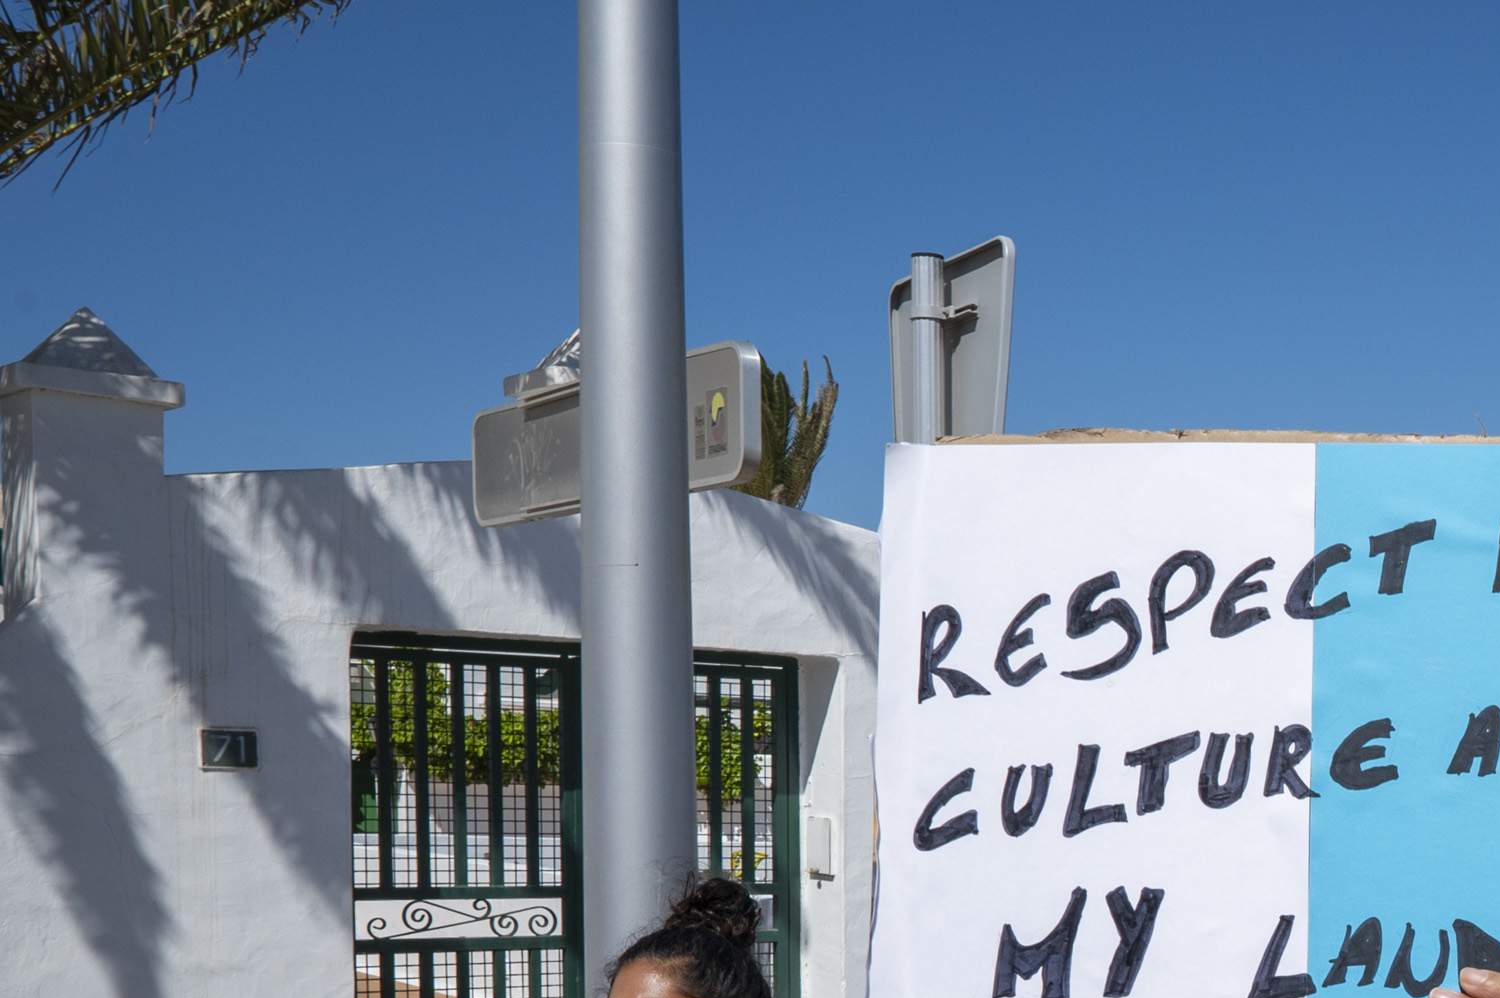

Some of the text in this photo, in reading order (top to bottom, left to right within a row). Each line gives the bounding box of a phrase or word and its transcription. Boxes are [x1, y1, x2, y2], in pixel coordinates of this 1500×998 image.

[918, 518, 1437, 704] RESPECT
[211, 734, 246, 763] 71
[913, 723, 1399, 851] CULTURE
